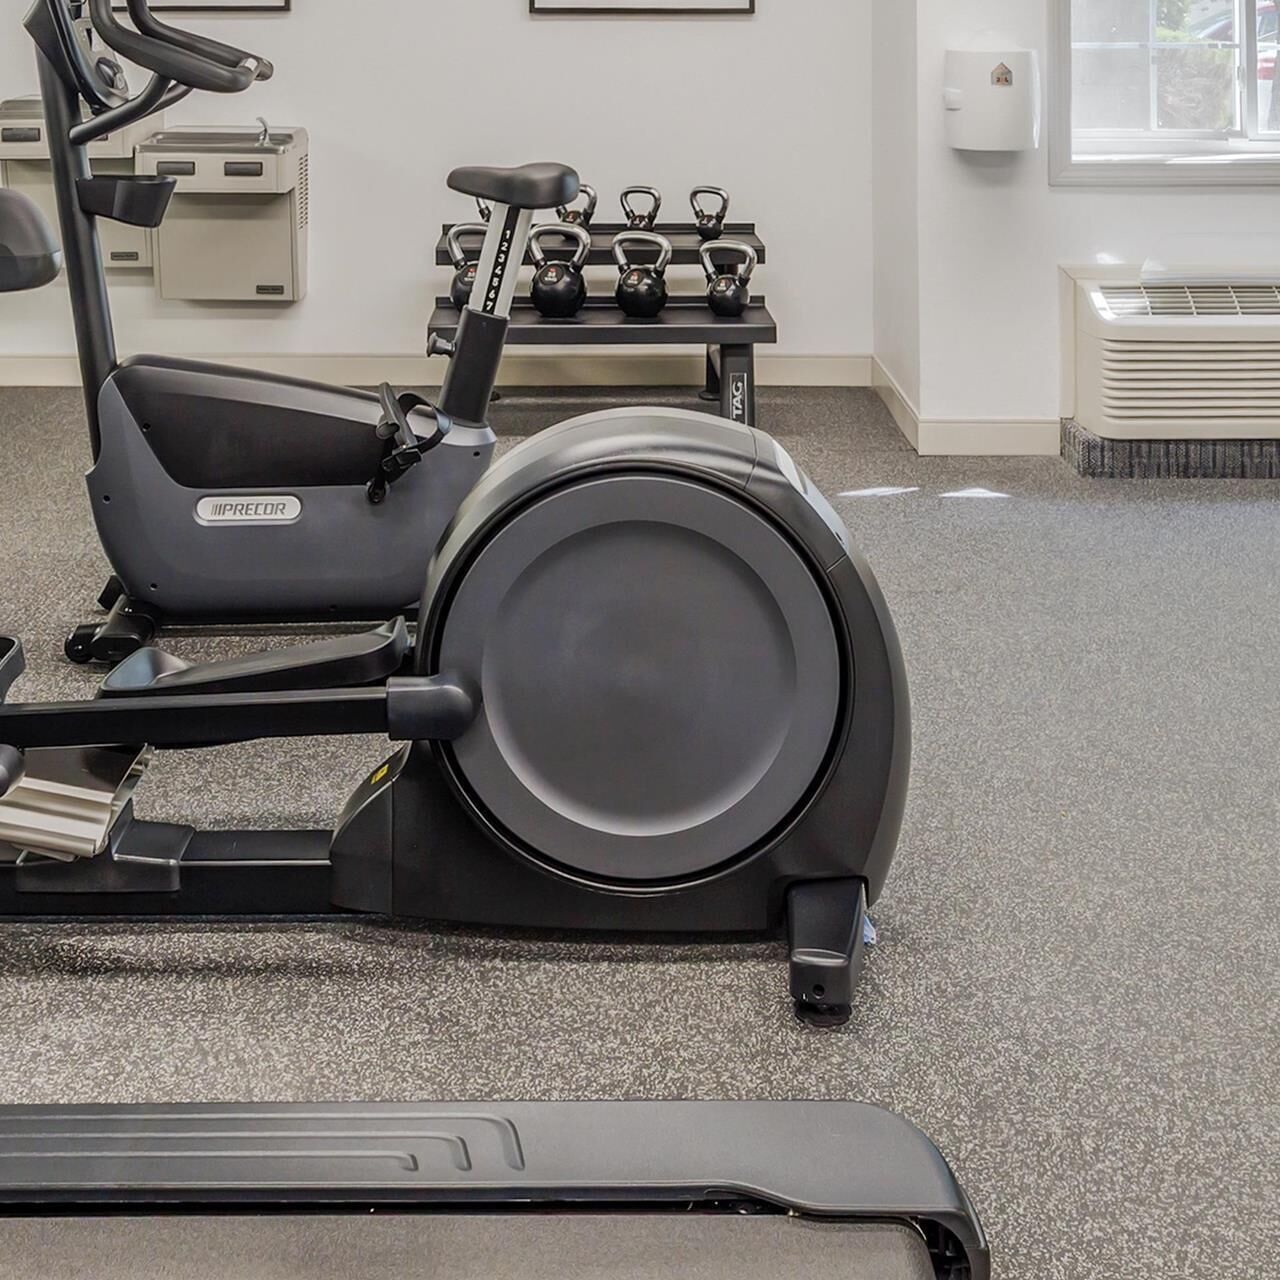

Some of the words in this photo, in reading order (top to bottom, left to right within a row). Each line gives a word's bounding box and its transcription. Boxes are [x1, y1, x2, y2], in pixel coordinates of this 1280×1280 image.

[505, 230, 511, 239] 1
[501, 242, 508, 251] 2
[498, 254, 505, 263] 3
[494, 266, 502, 275] 4
[491, 277, 499, 286] 5
[488, 290, 496, 299] 6
[486, 301, 493, 310] 7
[732, 381, 743, 419] TAG
[221, 502, 287, 516] PRECOR
